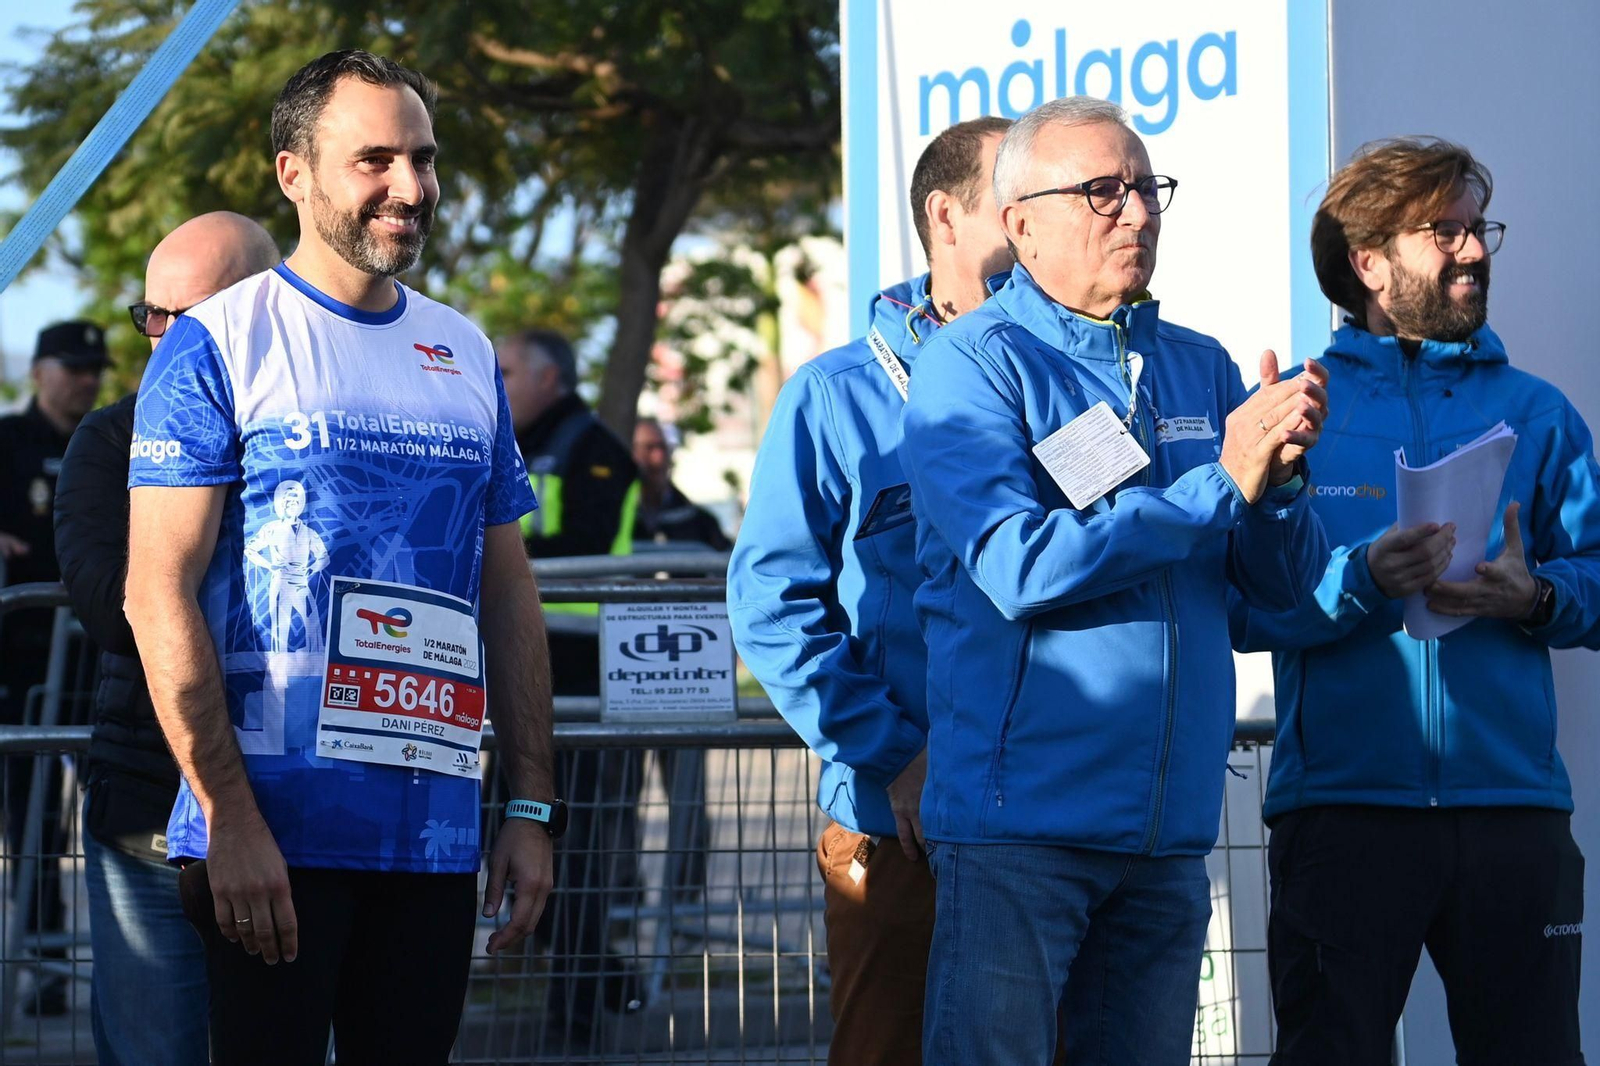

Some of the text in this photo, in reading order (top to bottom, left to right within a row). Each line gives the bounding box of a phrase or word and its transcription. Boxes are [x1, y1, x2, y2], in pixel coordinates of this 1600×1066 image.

[420, 364, 462, 375] TotalEnergies
[889, 362, 900, 374] DE
[283, 411, 330, 451] 31
[332, 410, 480, 442] TotalEnergies
[336, 437, 481, 463] 1/2 MARATÓN MÁLAGA
[1316, 483, 1387, 500] cronochip
[355, 638, 411, 654] TotalEnergies
[424, 637, 467, 656] 1/2 MARATÓN
[423, 650, 476, 671] DE MÁLAGA 2022
[608, 667, 730, 684] deporinter
[374, 672, 455, 718] 5646
[381, 717, 445, 736] DANI PÉREZ
[344, 740, 374, 751] CaixaBank
